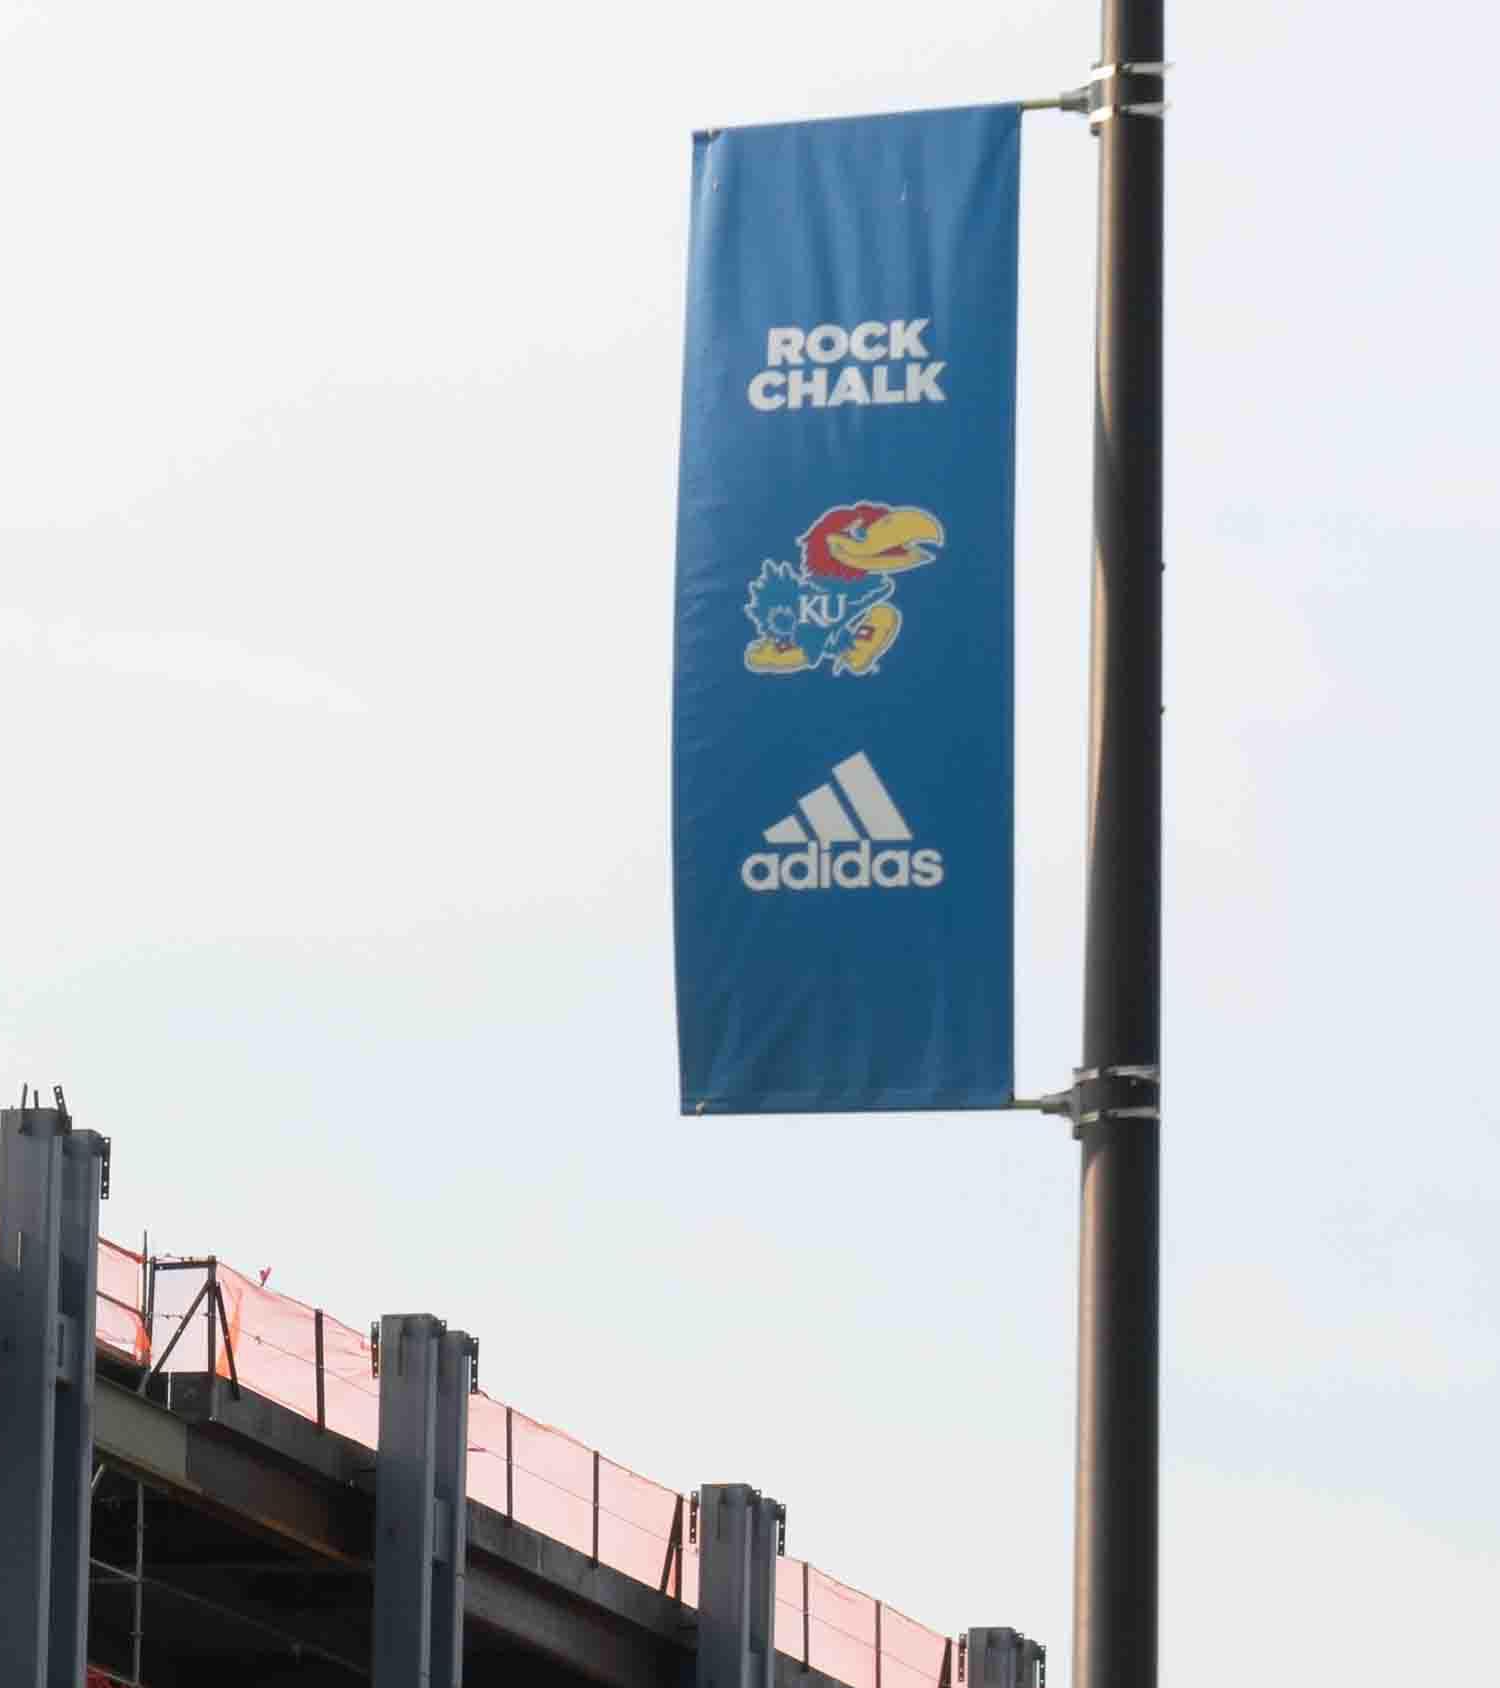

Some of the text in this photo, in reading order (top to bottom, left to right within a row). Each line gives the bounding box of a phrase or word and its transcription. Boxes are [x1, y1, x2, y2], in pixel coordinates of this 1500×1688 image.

[767, 318, 930, 367] ROCK
[747, 361, 948, 412] CHALK
[799, 593, 849, 627] KU
[741, 840, 945, 891] adidas
